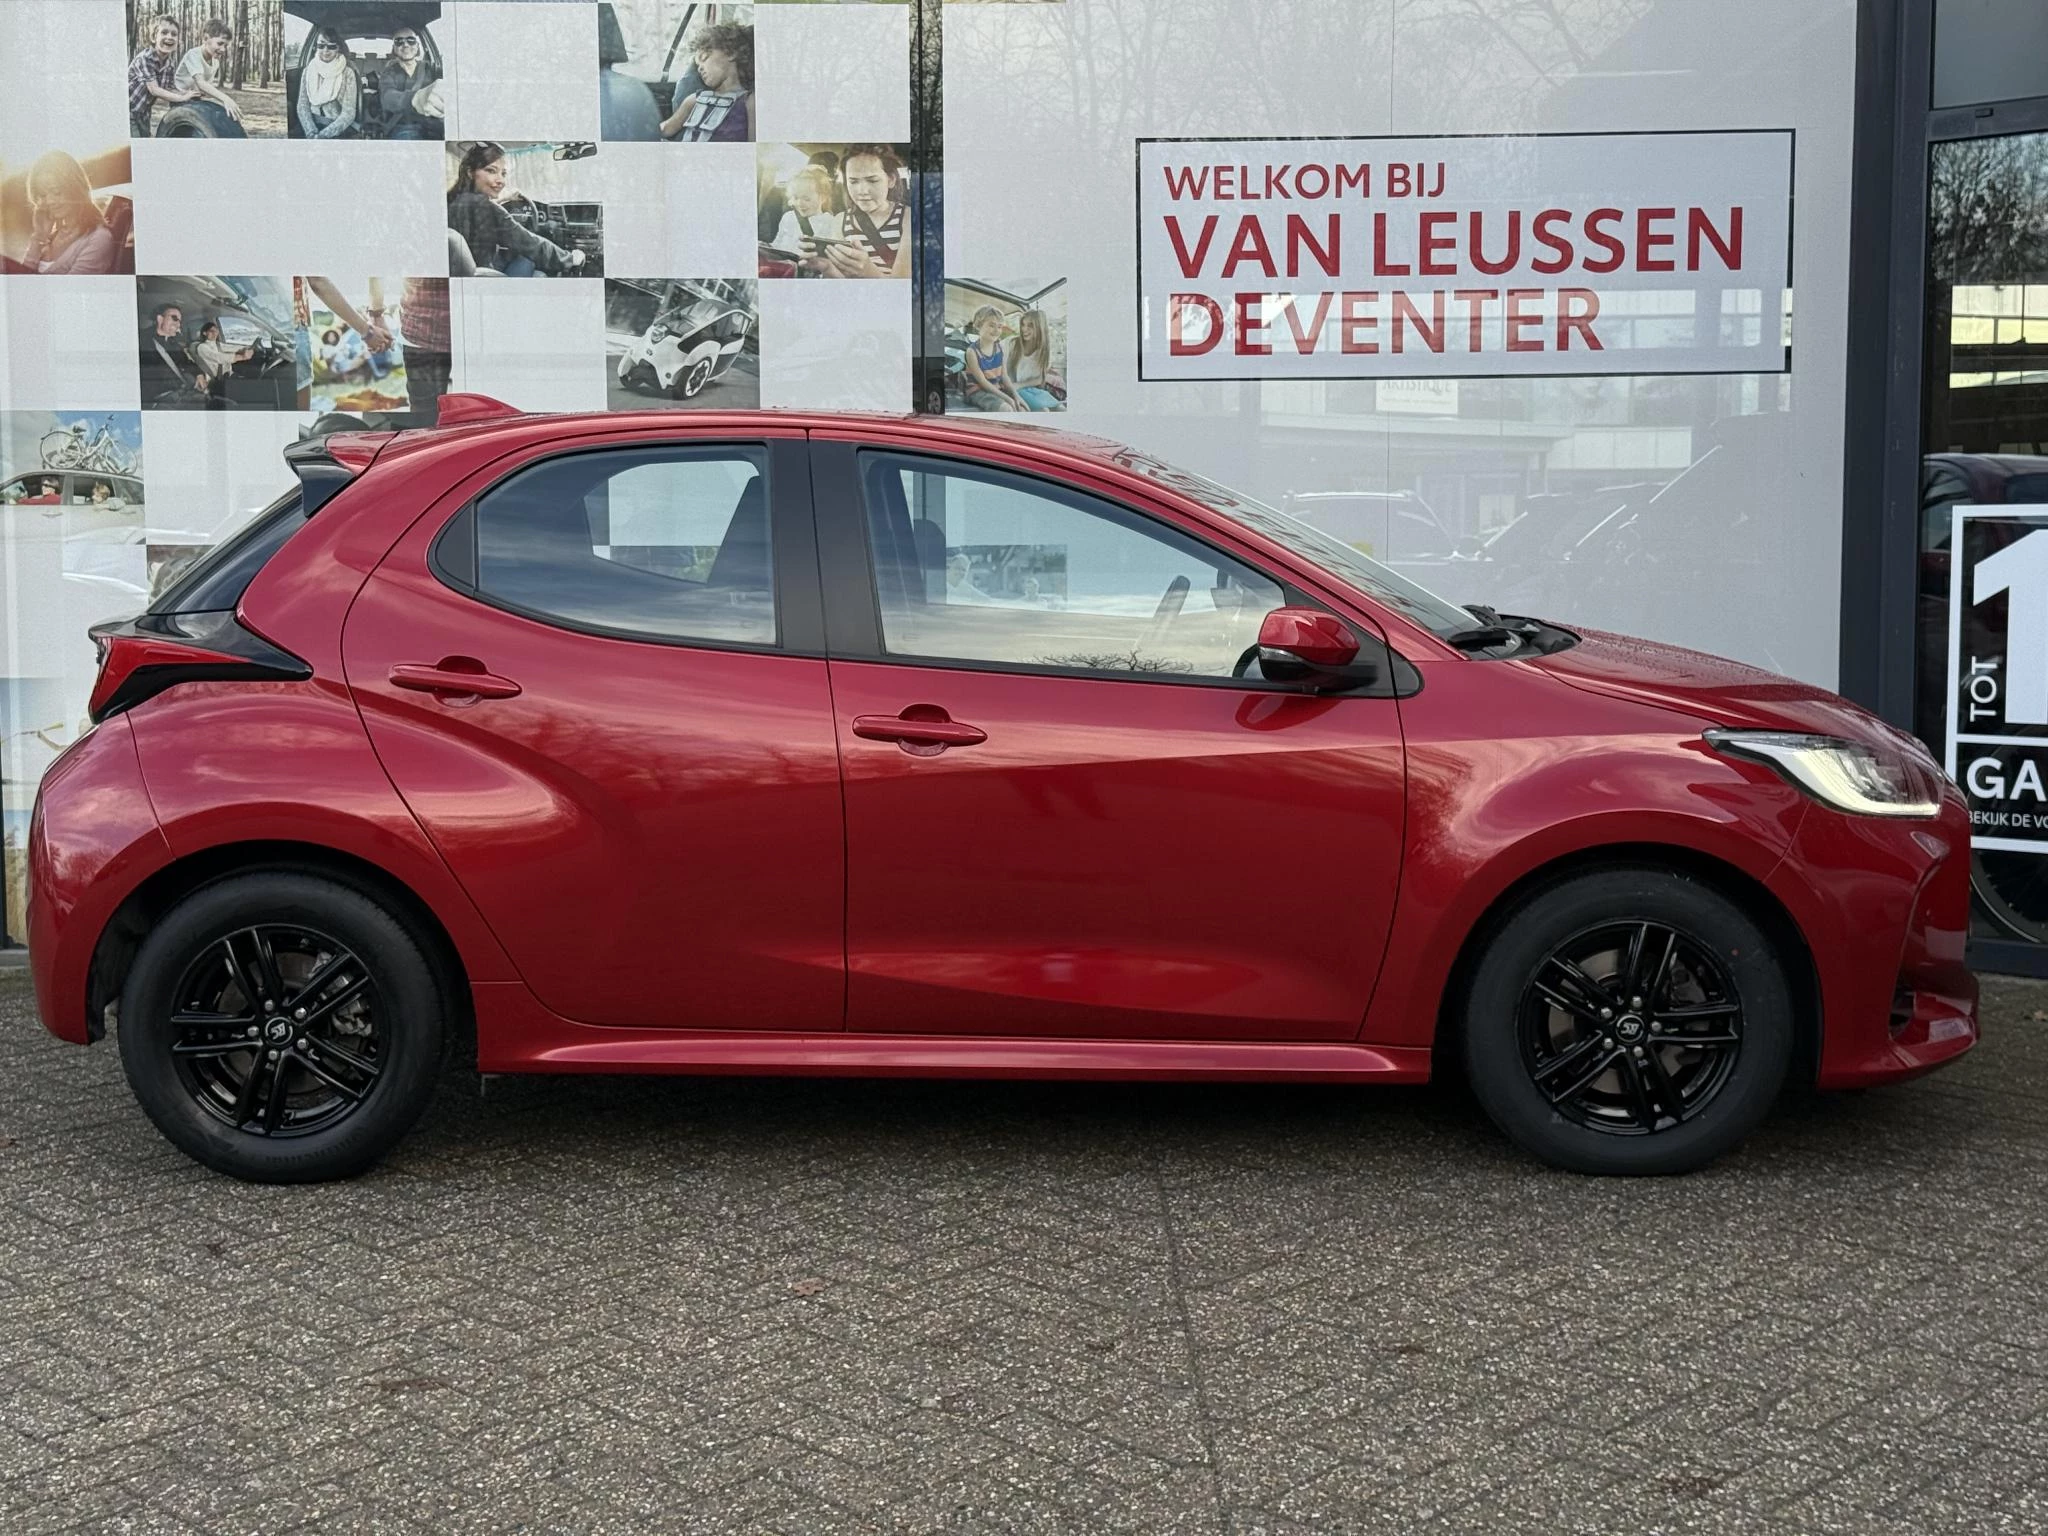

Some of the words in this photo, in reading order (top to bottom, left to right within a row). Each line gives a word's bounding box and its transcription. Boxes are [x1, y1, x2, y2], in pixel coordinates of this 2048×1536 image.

[1164, 164, 1370, 200] WELKOM
[1388, 162, 1445, 197] BIJ
[1164, 213, 1340, 278] VAN
[1373, 207, 1743, 276] LEUSSEN
[1170, 288, 1604, 356] DEVENTER
[1970, 656, 1998, 722] TOT
[1967, 757, 2047, 803] GA
[2012, 813, 2031, 828] DE
